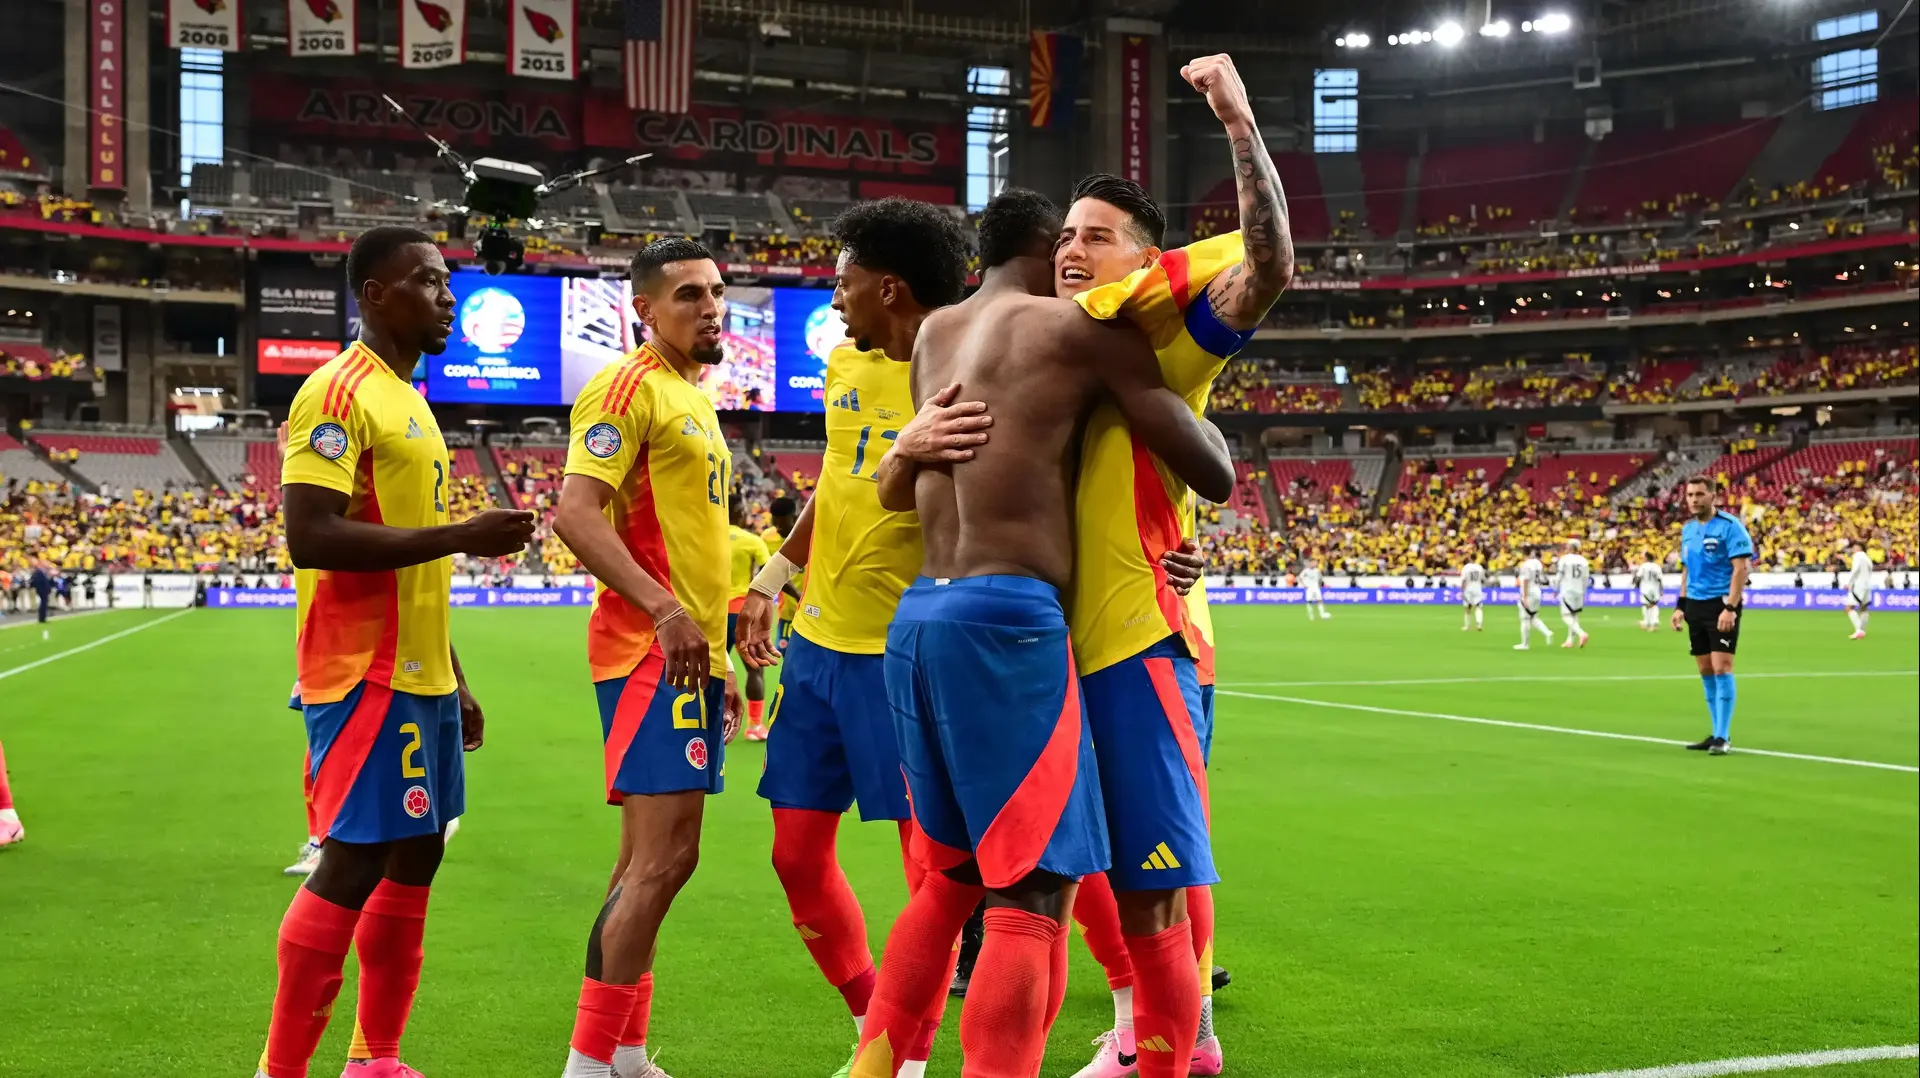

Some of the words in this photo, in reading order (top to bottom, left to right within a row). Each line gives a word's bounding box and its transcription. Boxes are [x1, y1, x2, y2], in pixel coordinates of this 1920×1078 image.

[179, 30, 229, 46] 2008
[298, 38, 345, 51] 2008
[100, 2, 115, 108] OTBALL
[412, 49, 453, 64] 2009
[521, 57, 565, 73] 2015
[298, 88, 571, 139] ARIZONA
[635, 114, 939, 165] CARDINALS
[1130, 58, 1140, 181] ESTABLISHE
[100, 113, 115, 182] CLUB
[261, 287, 293, 299] GILA
[295, 289, 336, 300] RIVER
[443, 364, 481, 378] COPA
[480, 365, 541, 380] AMERICA
[788, 376, 824, 388] COPA
[434, 460, 444, 512] 2
[708, 453, 726, 508] 21
[236, 592, 296, 605] despega
[502, 592, 561, 604] despegar
[1257, 590, 1303, 603] despegar
[1323, 591, 1368, 603] despegar
[1387, 591, 1435, 603] despegar
[1751, 592, 1797, 606] despegar
[1886, 593, 1919, 607] despe
[672, 676, 707, 729] 21
[399, 722, 426, 779] 2
